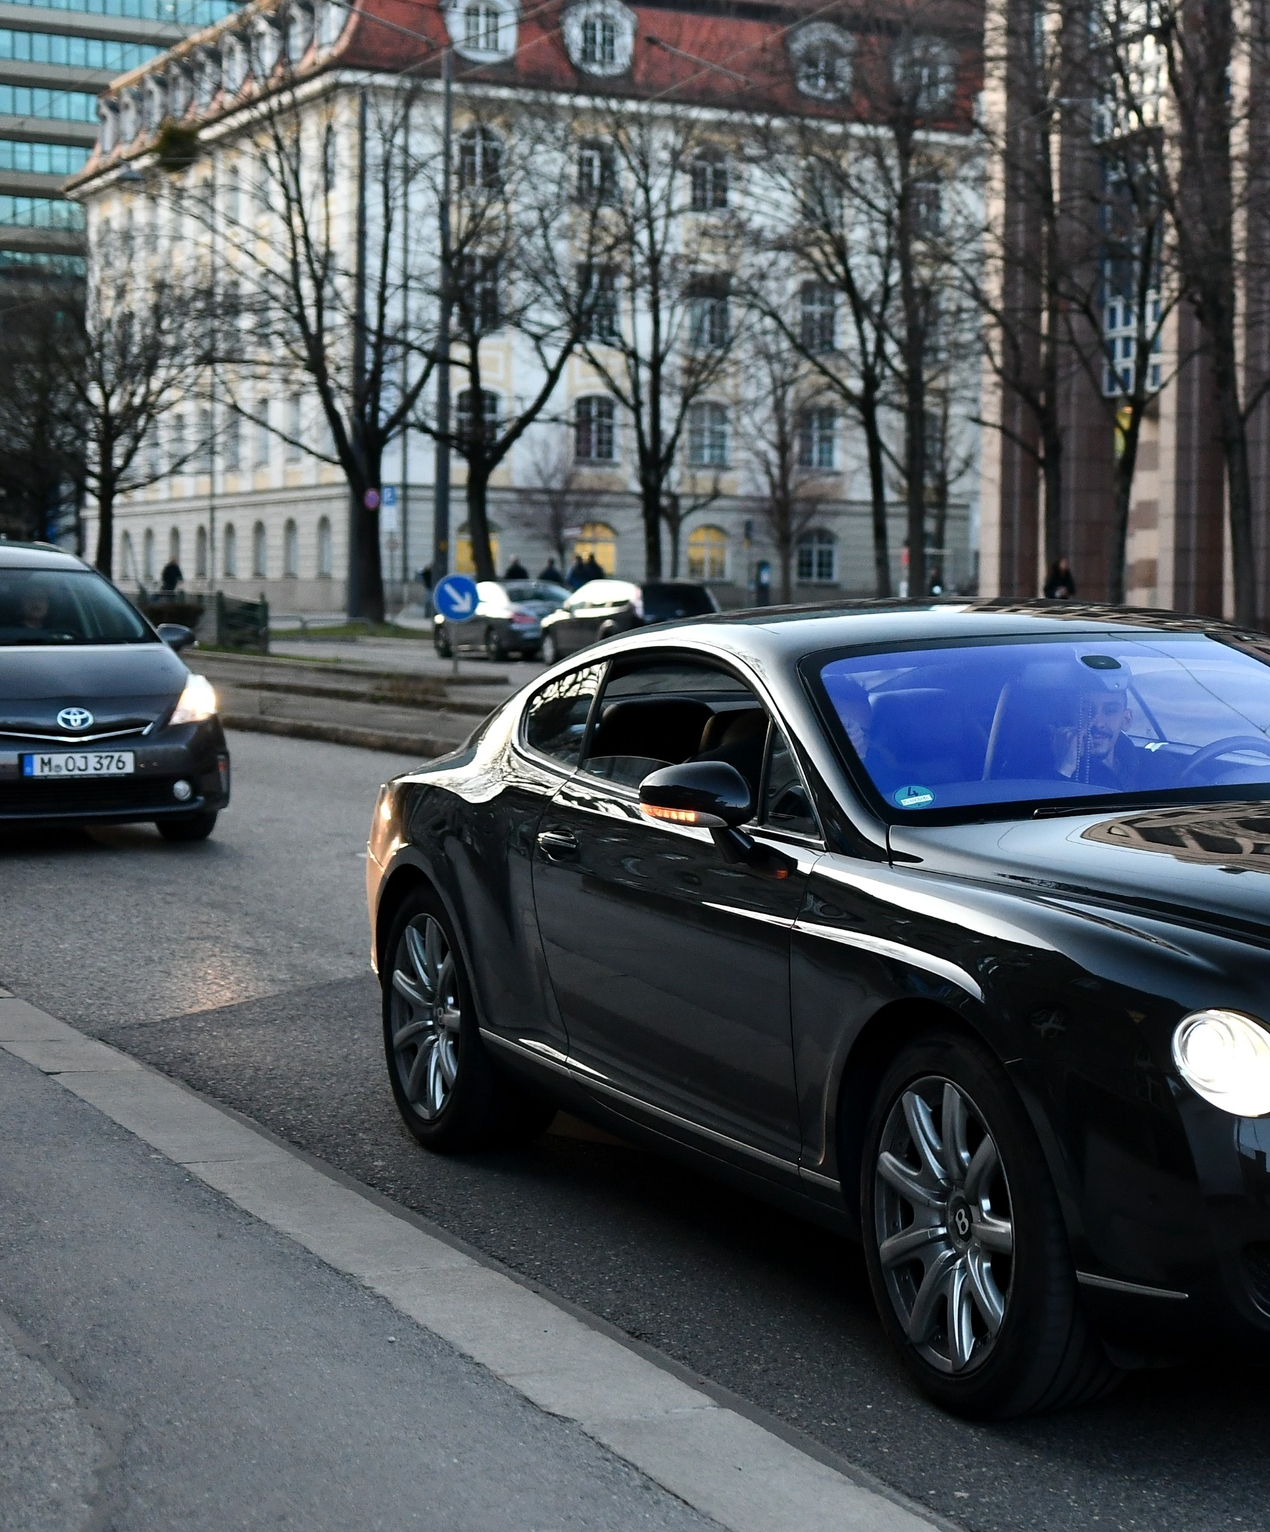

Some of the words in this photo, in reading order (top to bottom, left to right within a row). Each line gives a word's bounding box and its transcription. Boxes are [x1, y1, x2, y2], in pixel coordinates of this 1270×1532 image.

[40, 756, 52, 773] M
[93, 754, 126, 771] 376
[907, 786, 919, 797] 4
[955, 1208, 969, 1235] B
